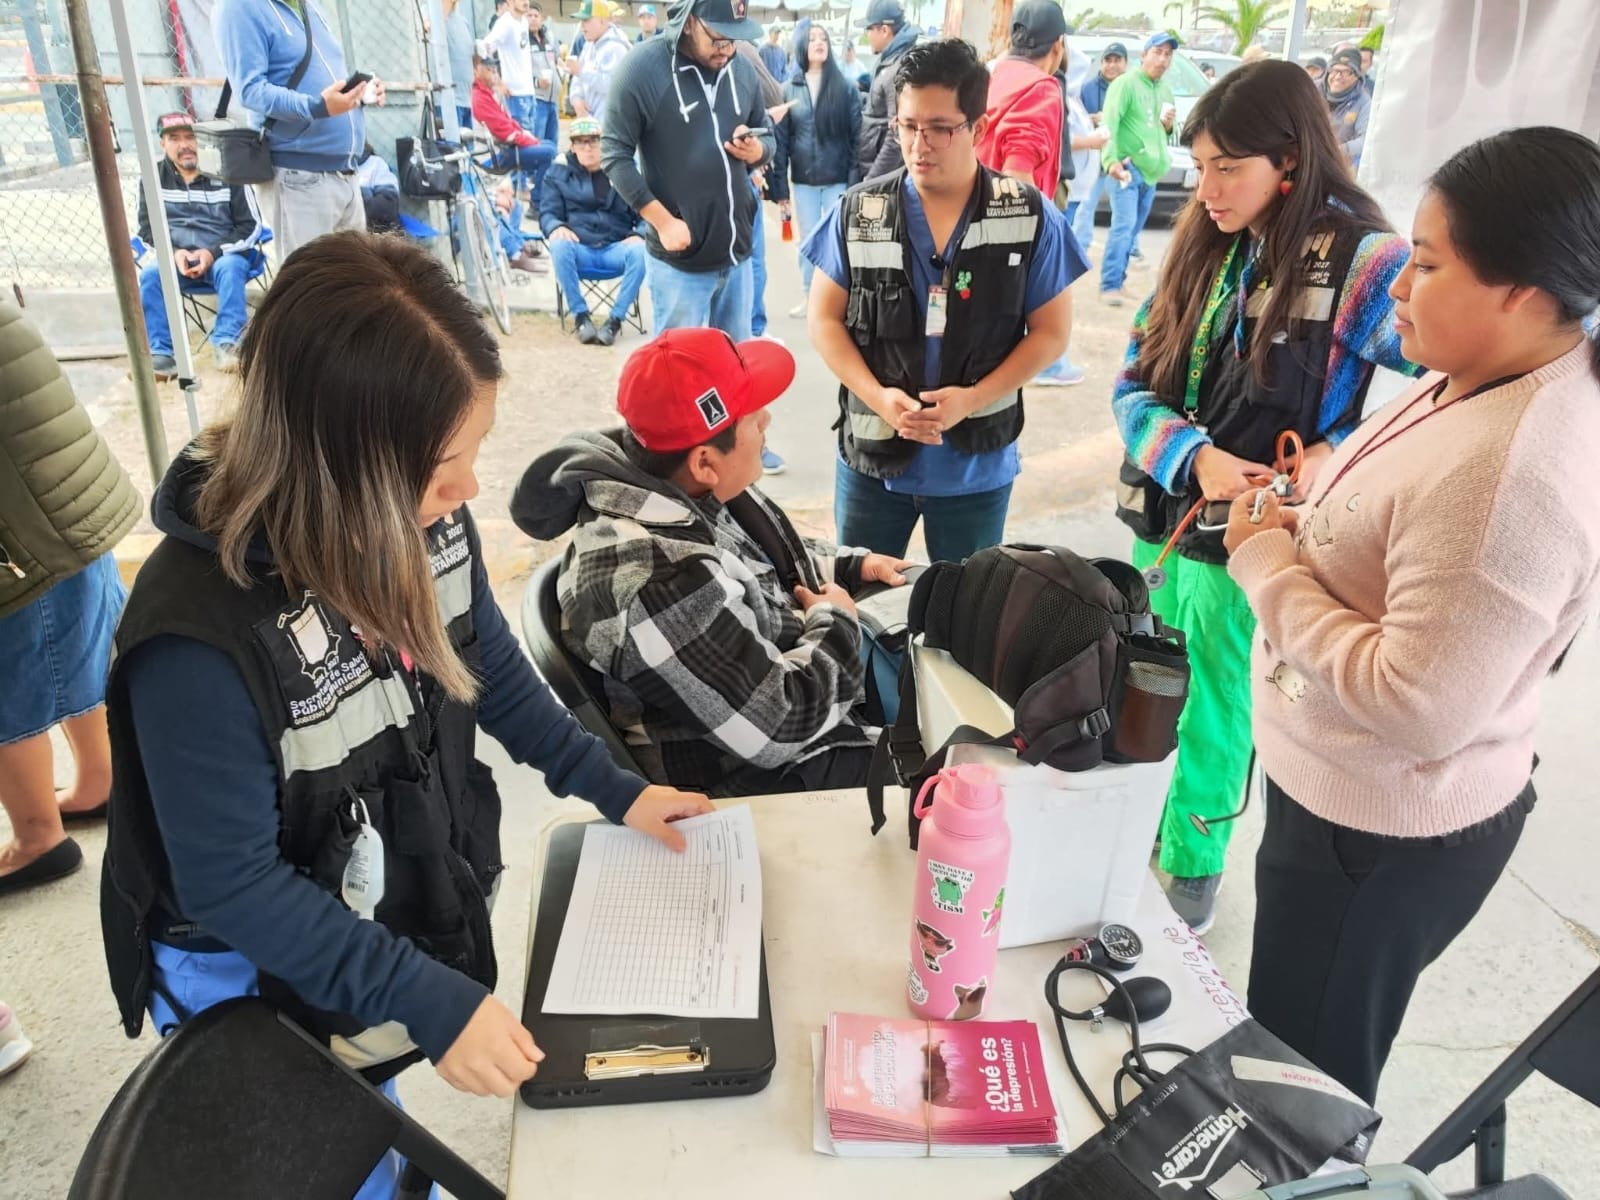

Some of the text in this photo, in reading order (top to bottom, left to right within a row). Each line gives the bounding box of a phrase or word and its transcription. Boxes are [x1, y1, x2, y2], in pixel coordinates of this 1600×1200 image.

[446, 523, 463, 540] 2027
[327, 655, 340, 671] 2027
[329, 669, 340, 681] de
[1163, 927, 1188, 945] de
[979, 1037, 1011, 1113] ¿Qué es
[1000, 1037, 1024, 1113] la depresión?
[1161, 1102, 1253, 1179] Homecare
